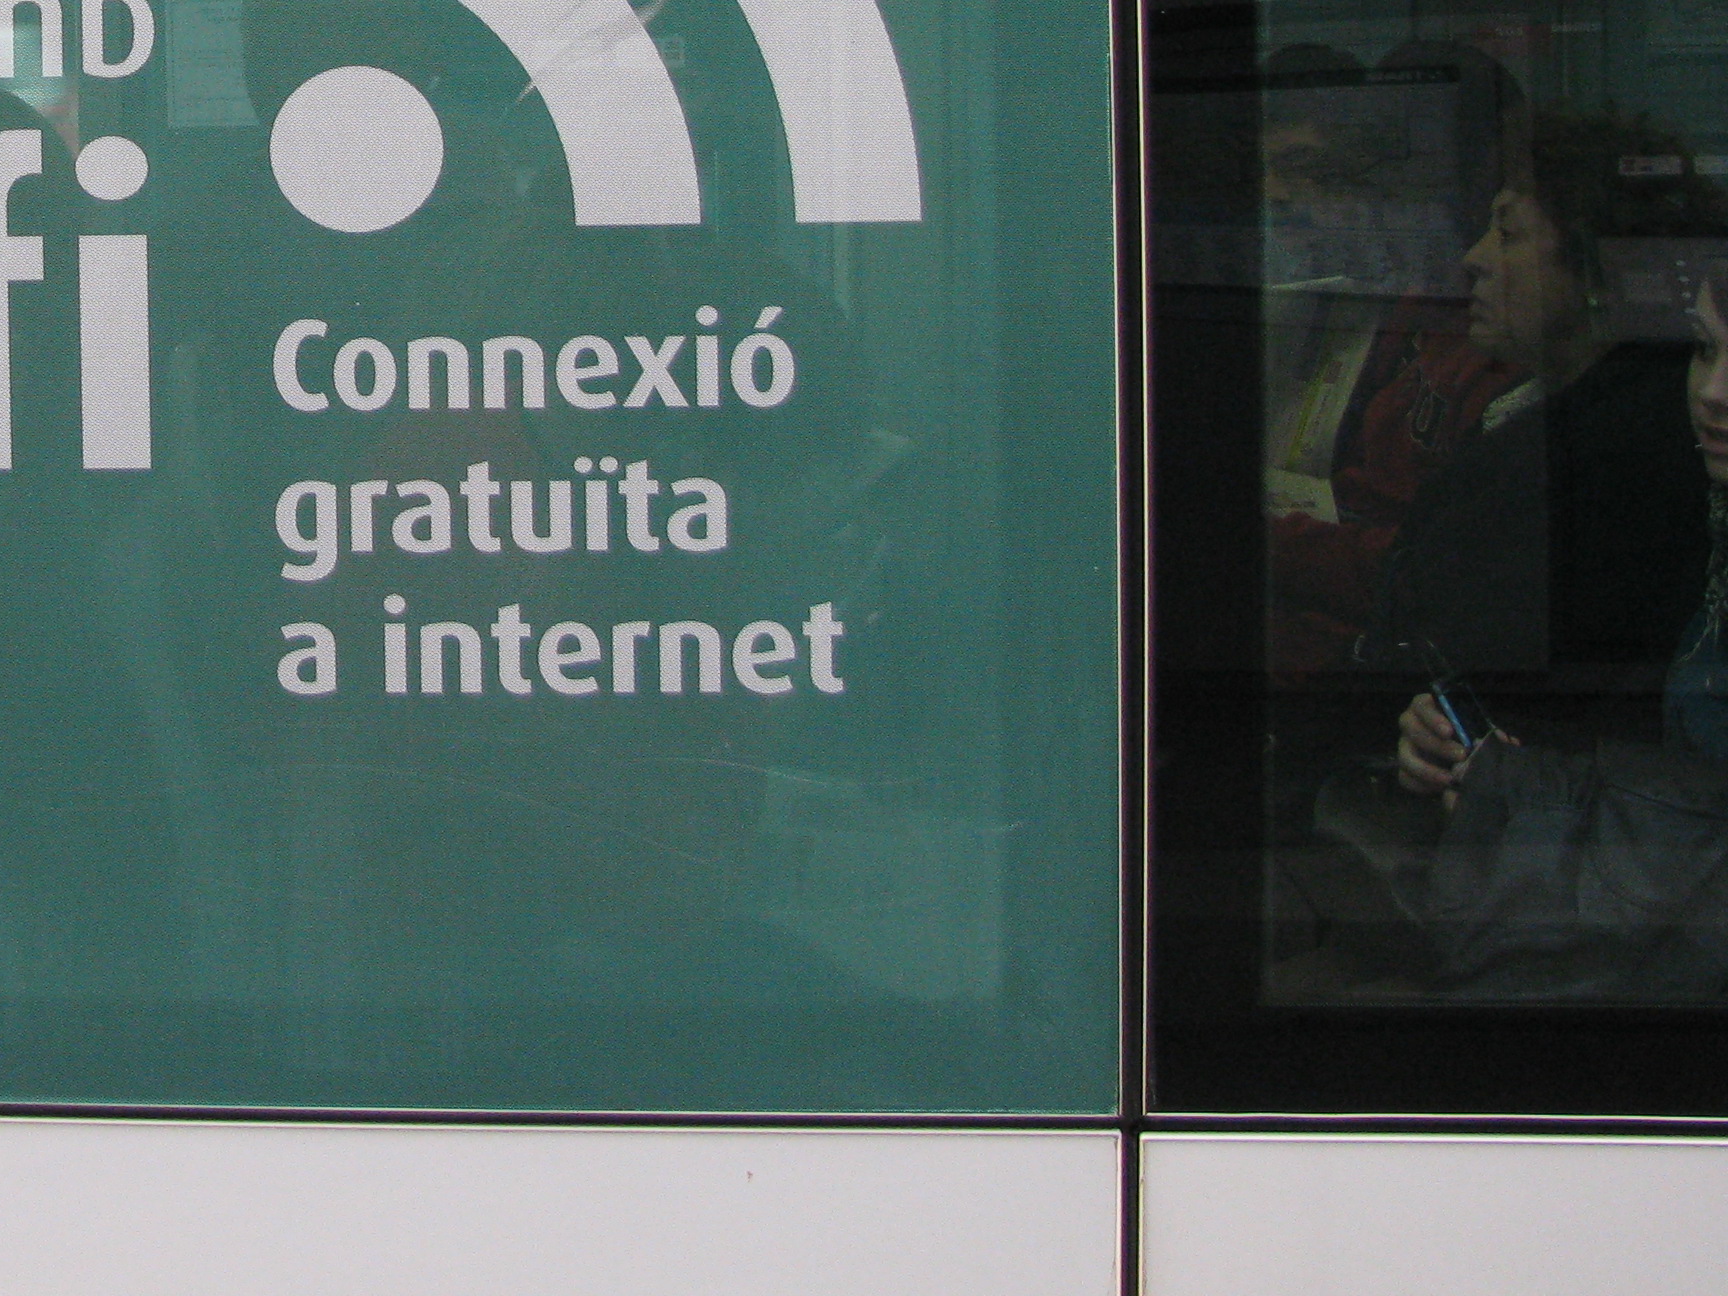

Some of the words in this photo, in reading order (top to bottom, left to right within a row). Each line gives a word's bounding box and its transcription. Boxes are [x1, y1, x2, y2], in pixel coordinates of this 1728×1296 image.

[273, 306, 796, 412] Connexió
[275, 461, 728, 582] gratuïta
[278, 622, 337, 695] a
[384, 594, 845, 695] internet
